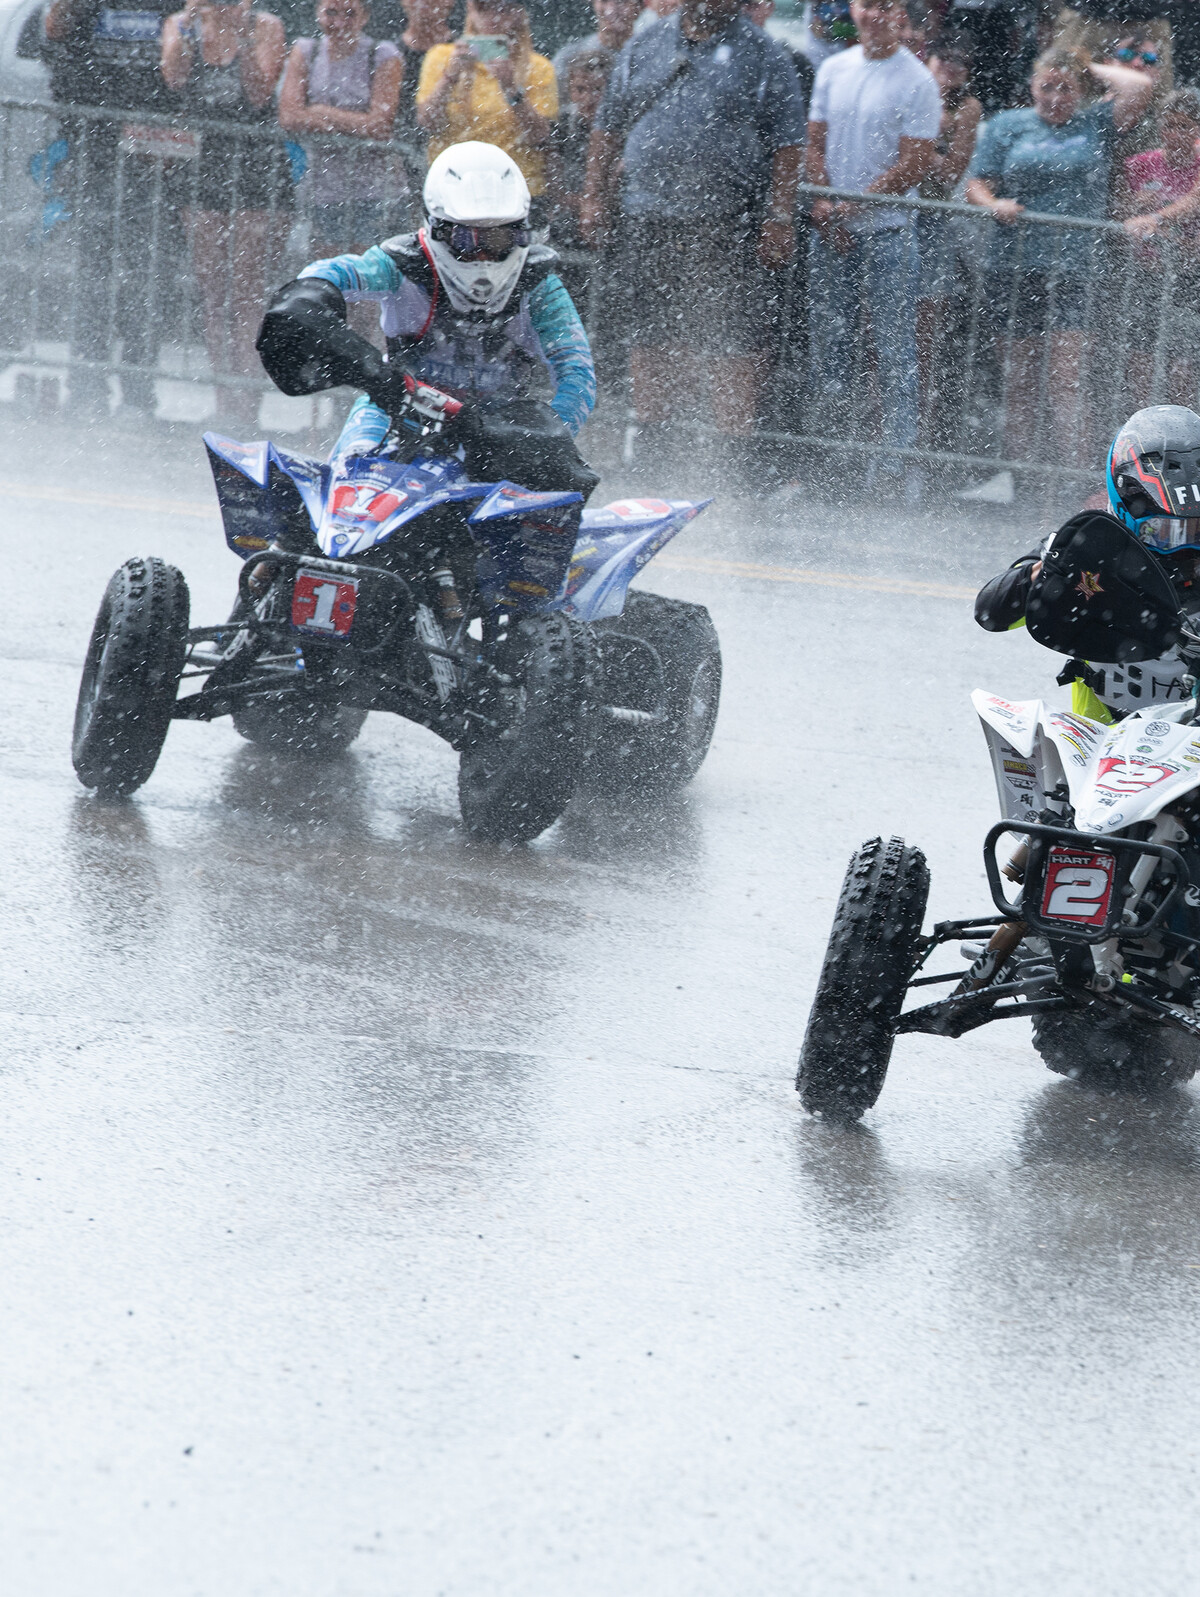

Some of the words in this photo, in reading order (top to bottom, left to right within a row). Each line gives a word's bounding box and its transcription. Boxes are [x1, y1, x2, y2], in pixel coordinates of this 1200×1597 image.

[336, 487, 375, 516] 1
[304, 583, 338, 631] 1
[1095, 763, 1166, 792] 2
[1051, 855, 1091, 865] HART
[1046, 867, 1109, 917] 2
